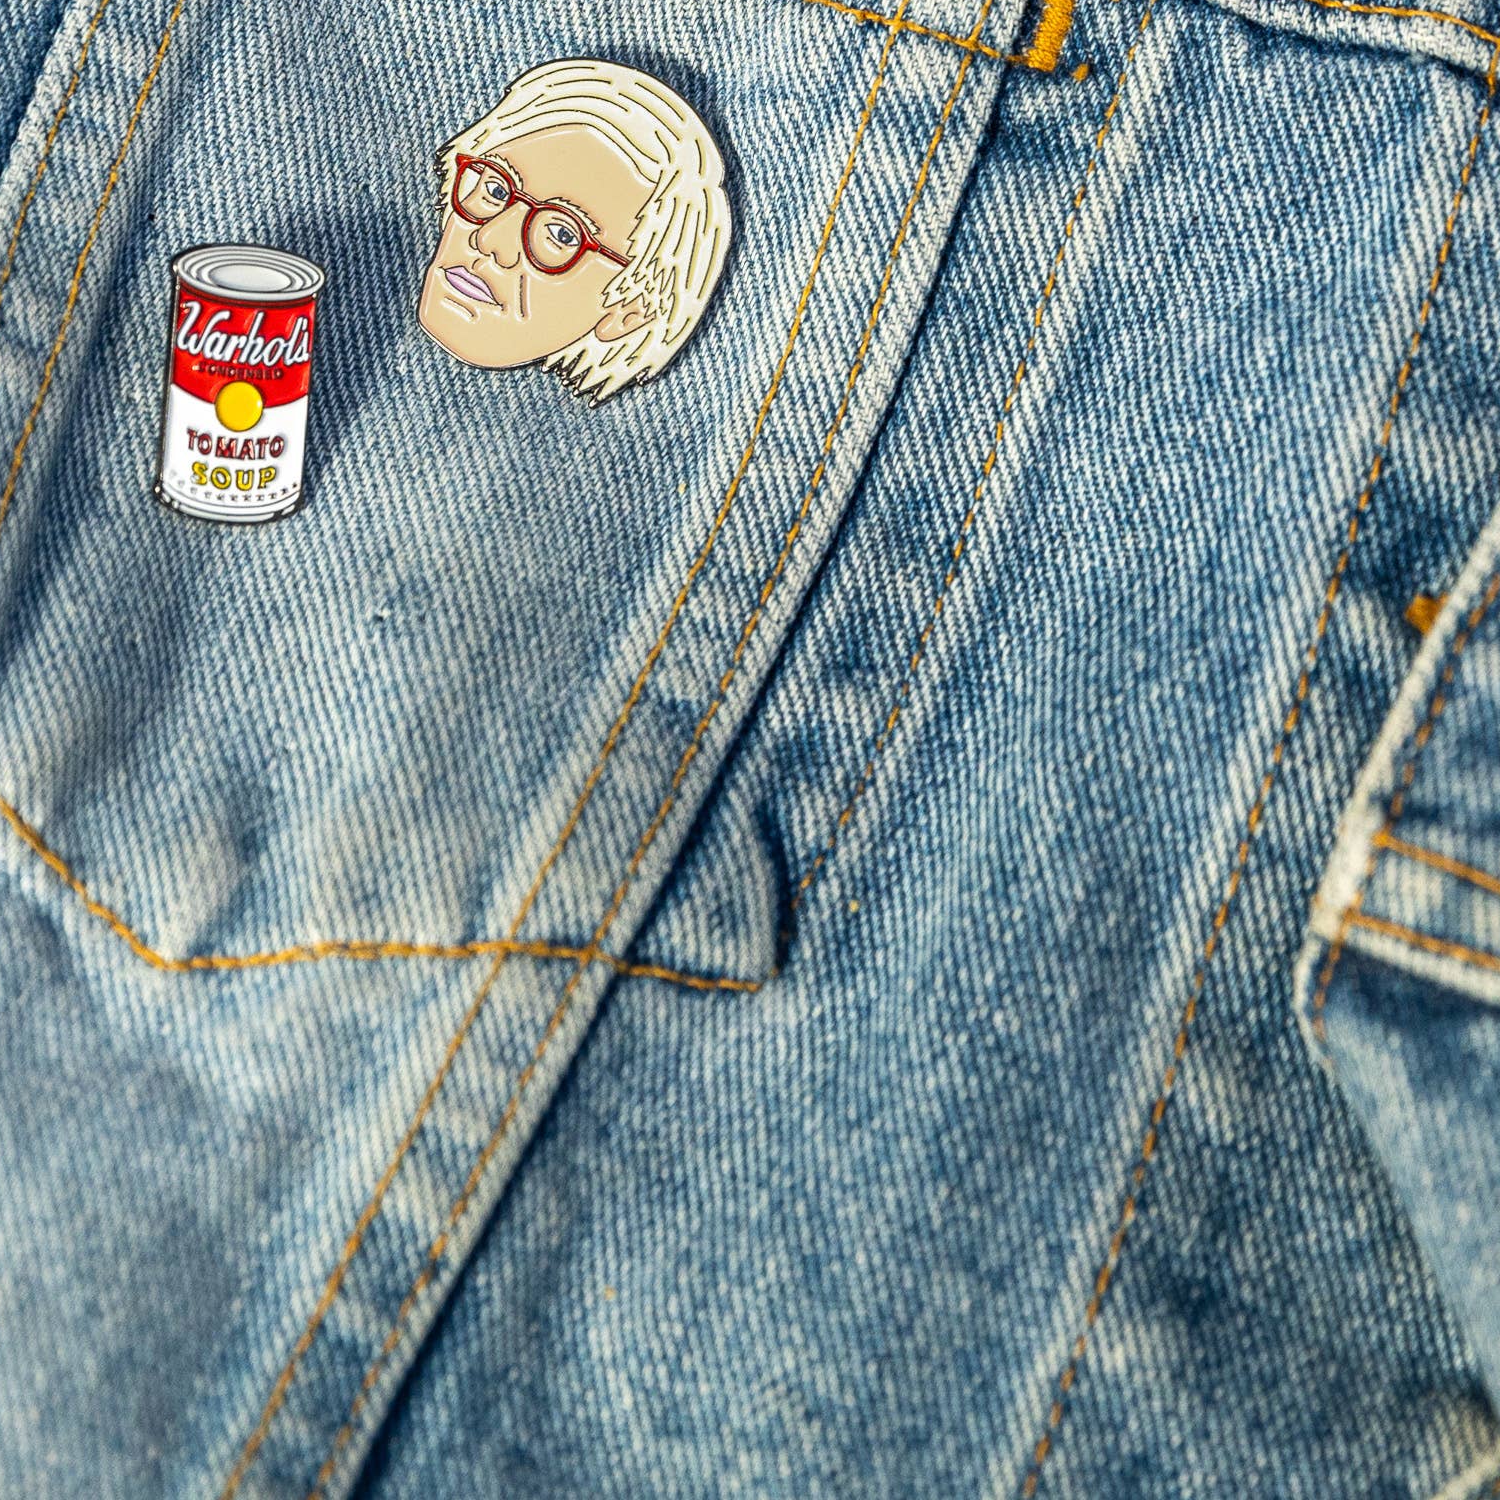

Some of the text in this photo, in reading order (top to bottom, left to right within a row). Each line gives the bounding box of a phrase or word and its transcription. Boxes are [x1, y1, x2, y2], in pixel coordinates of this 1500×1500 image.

[176, 300, 309, 366] Warhol's
[187, 427, 285, 461] TOMATO
[190, 461, 277, 491] SOUP
